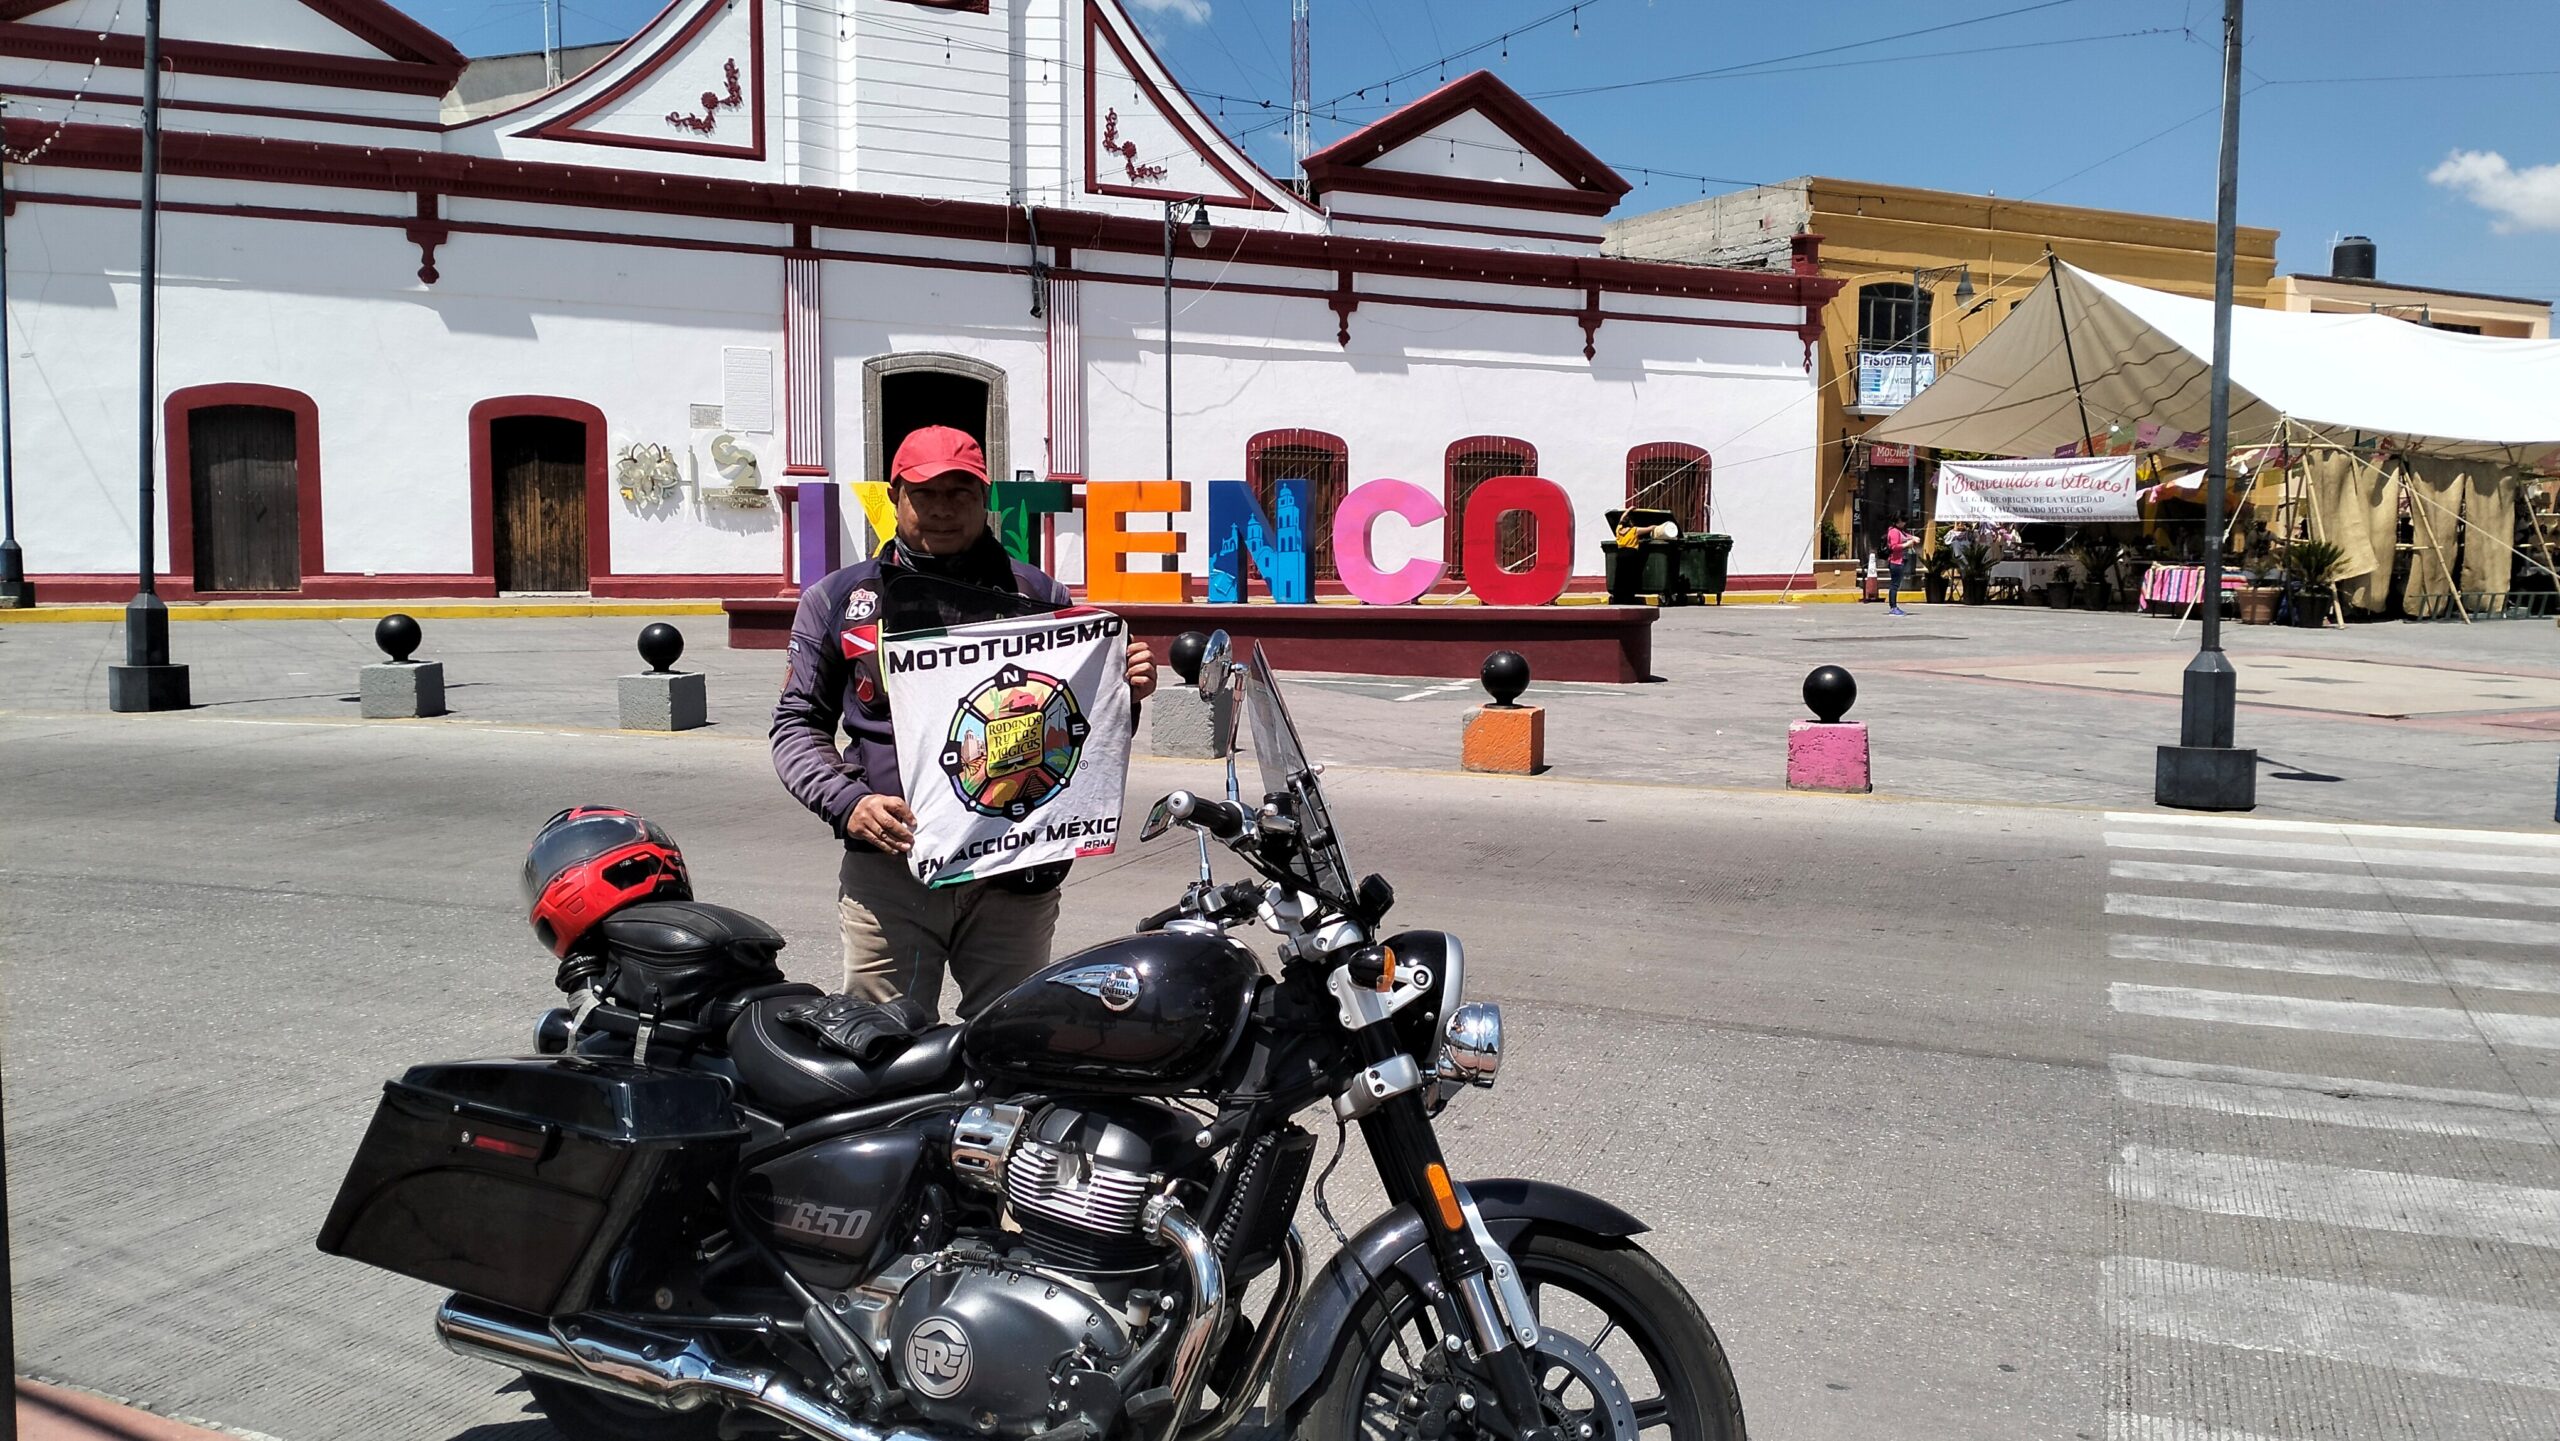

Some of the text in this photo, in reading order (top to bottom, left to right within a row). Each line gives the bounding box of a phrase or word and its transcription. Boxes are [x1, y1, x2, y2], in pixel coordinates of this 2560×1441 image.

[1945, 471, 2040, 496] ¡Bienvenidos
[2046, 476, 2057, 489] a
[1990, 496, 2001, 504] DE
[2002, 496, 2032, 504] ORIGEN
[2033, 496, 2046, 504] DE
[2047, 496, 2057, 504] LA
[2060, 496, 2105, 504] VARIEDAD
[2012, 506, 2046, 514] MORADO
[2048, 506, 2093, 514] MEXICANO
[798, 475, 1576, 606] ITENCO
[848, 601, 871, 617] 66
[889, 616, 1123, 674] MOTOTURISMO
[1002, 670, 1020, 684] N
[1071, 723, 1085, 736] E
[942, 751, 957, 766] O
[1011, 802, 1026, 816] S
[1083, 838, 1111, 850] RRM
[917, 856, 945, 880] EN
[949, 827, 1036, 865] ACCIÓN
[1105, 977, 1130, 989] ROYAL
[790, 1202, 872, 1240] 650
